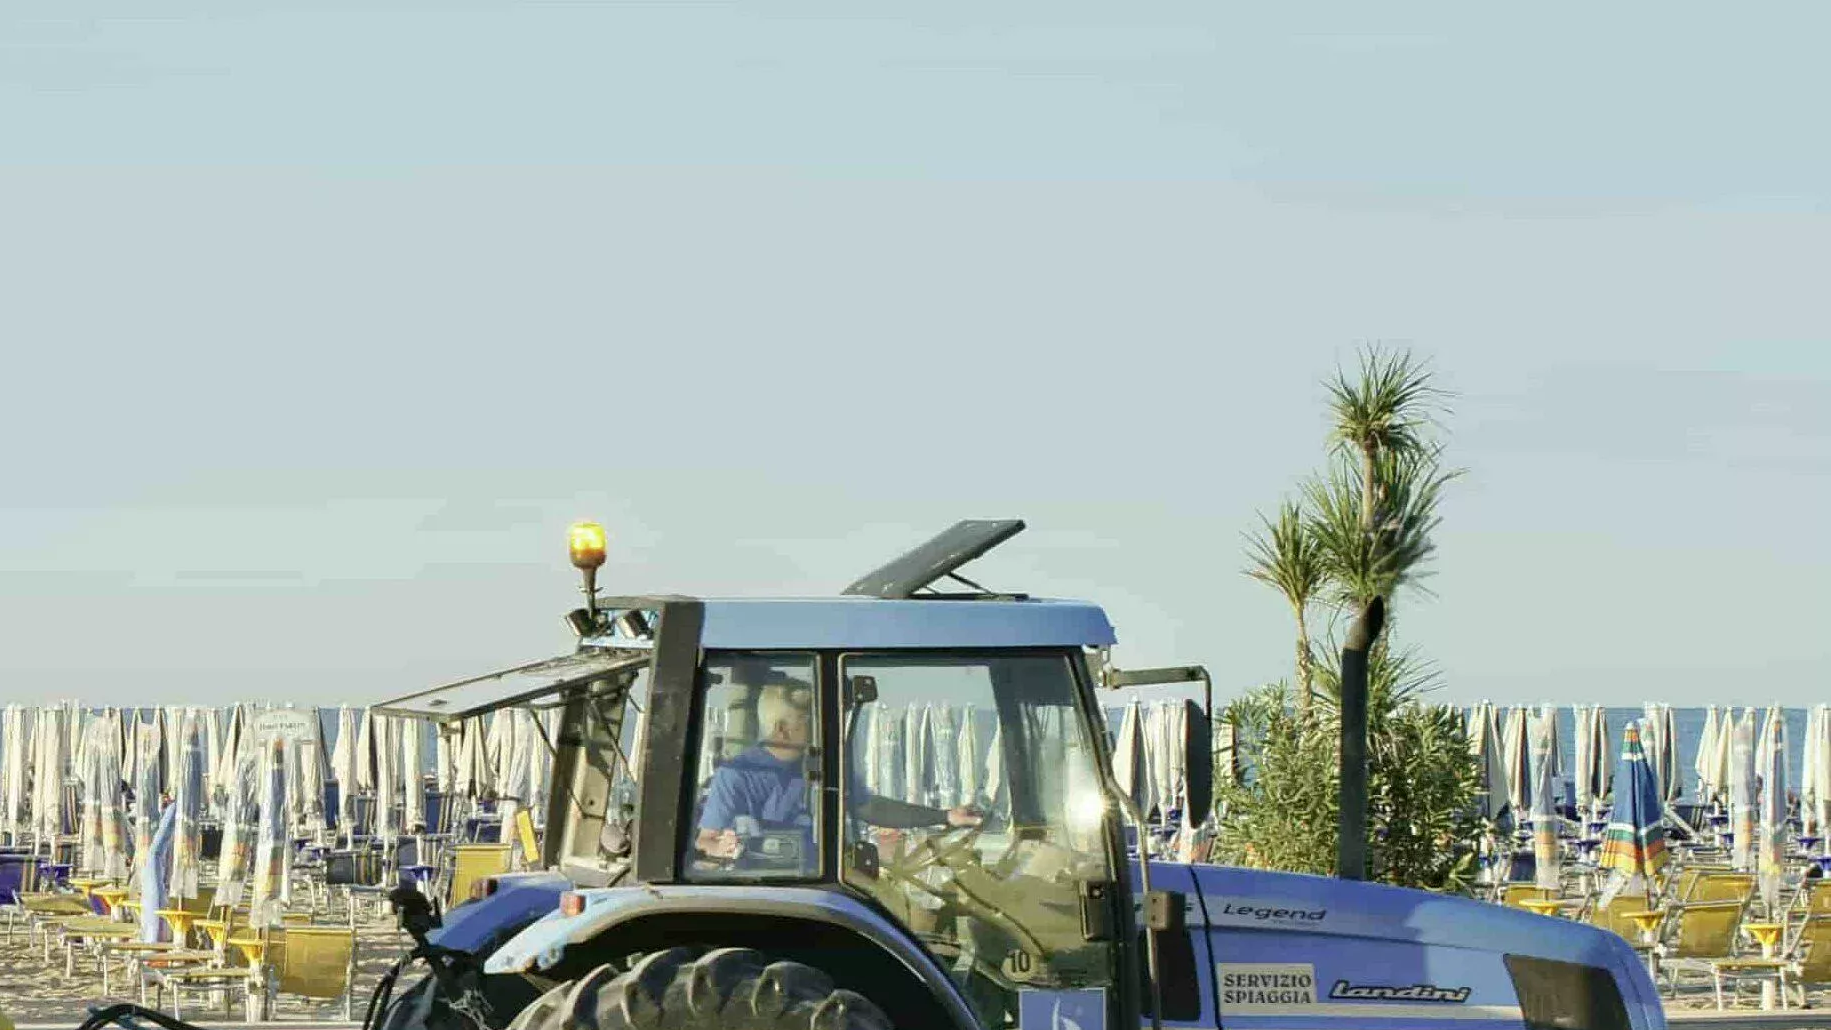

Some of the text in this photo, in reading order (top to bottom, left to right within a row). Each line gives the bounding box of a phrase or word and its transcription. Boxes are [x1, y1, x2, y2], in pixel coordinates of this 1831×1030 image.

[1223, 902, 1327, 921] Legend
[1010, 951, 1031, 973] 10
[1223, 973, 1312, 988] SERVIZIO
[1223, 990, 1312, 1004] SPIAGGIA
[1329, 979, 1471, 1003] Landini
